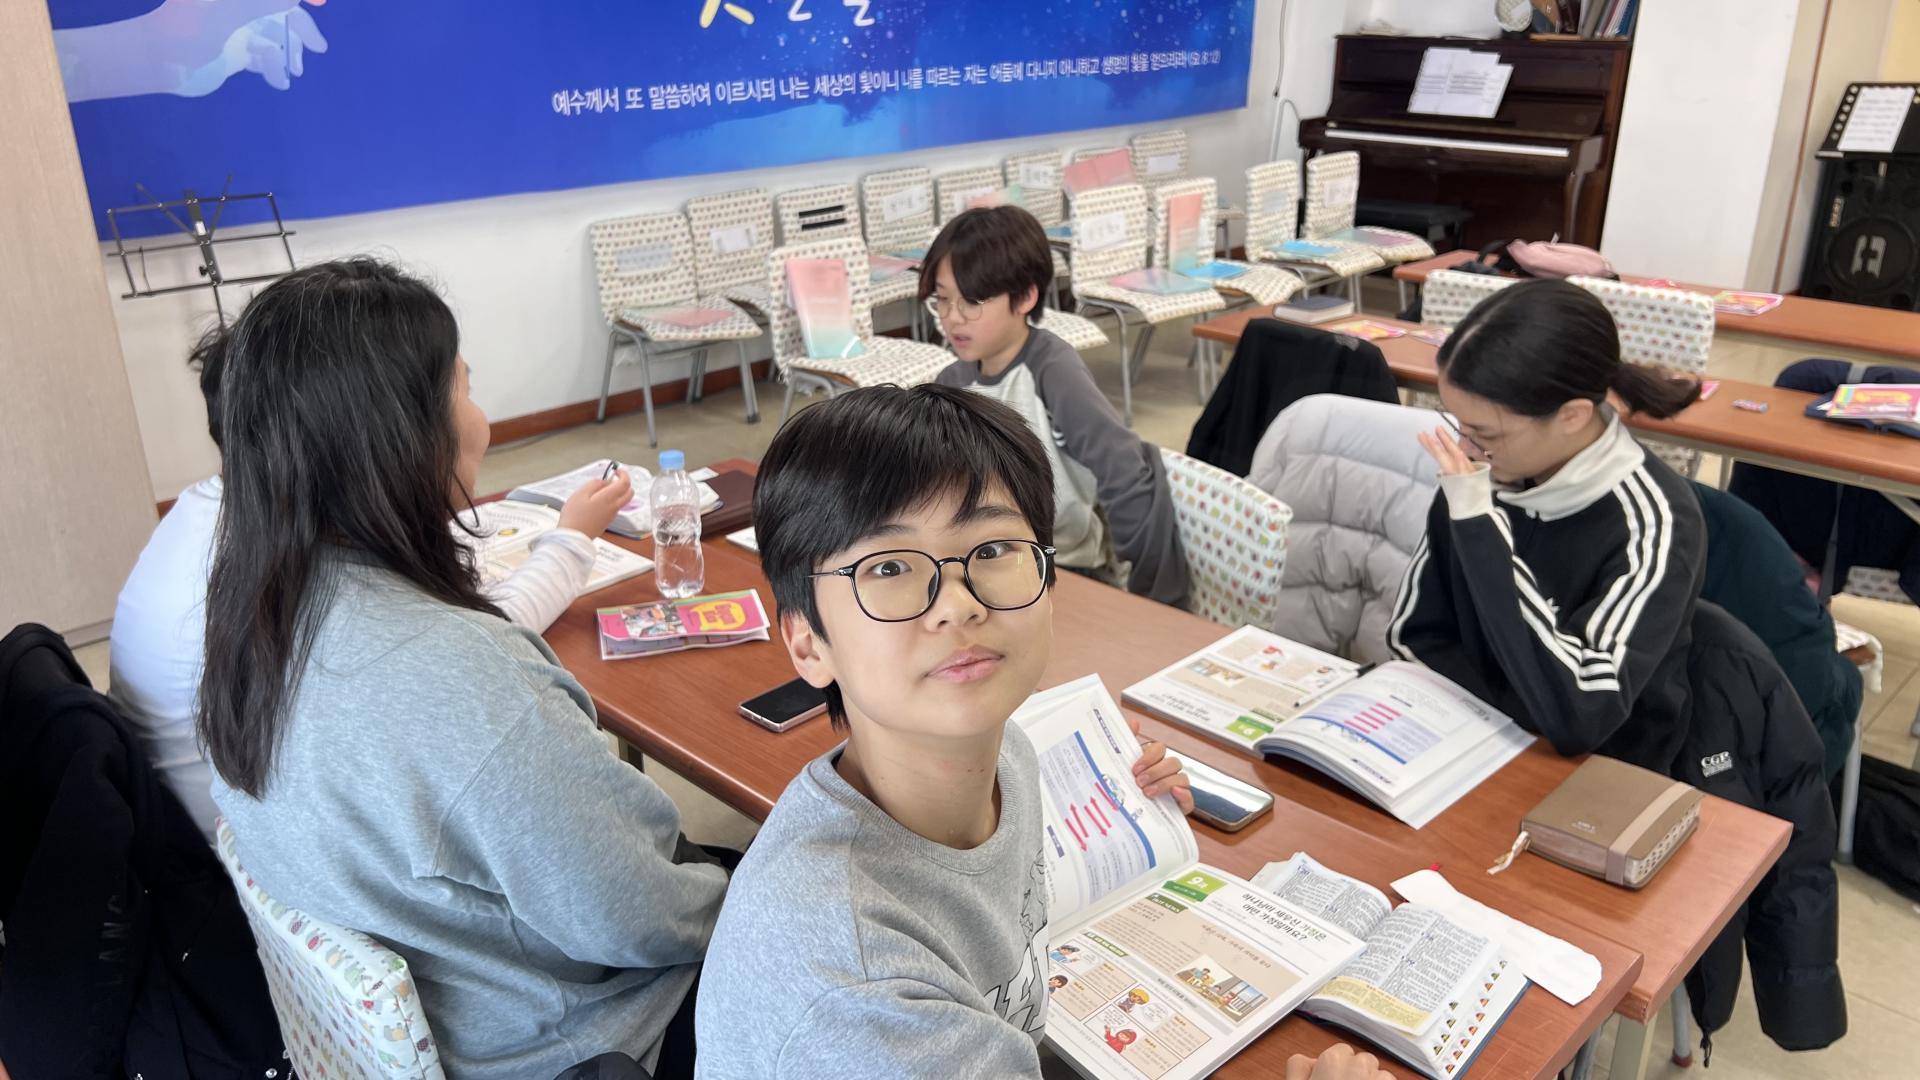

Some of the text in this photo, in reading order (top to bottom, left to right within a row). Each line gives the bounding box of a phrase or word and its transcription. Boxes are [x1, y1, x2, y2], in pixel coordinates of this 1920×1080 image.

[552, 87, 619, 116] 예수께서
[625, 88, 645, 110] 또
[649, 82, 712, 110] 말씀하여
[715, 77, 776, 104] 이르시되
[780, 75, 810, 100] 나는
[814, 72, 857, 97] 세상의
[859, 69, 899, 94] 빛이니
[901, 67, 923, 90] 나를
[926, 65, 961, 88] 따르는
[963, 64, 988, 85] 자는
[989, 61, 1024, 83] 어둠에
[1026, 59, 1057, 80] 다니지
[1059, 56, 1100, 77] 아니하고
[1102, 54, 1129, 75] 생명의
[1242, 893, 1276, 914] 하나님이
